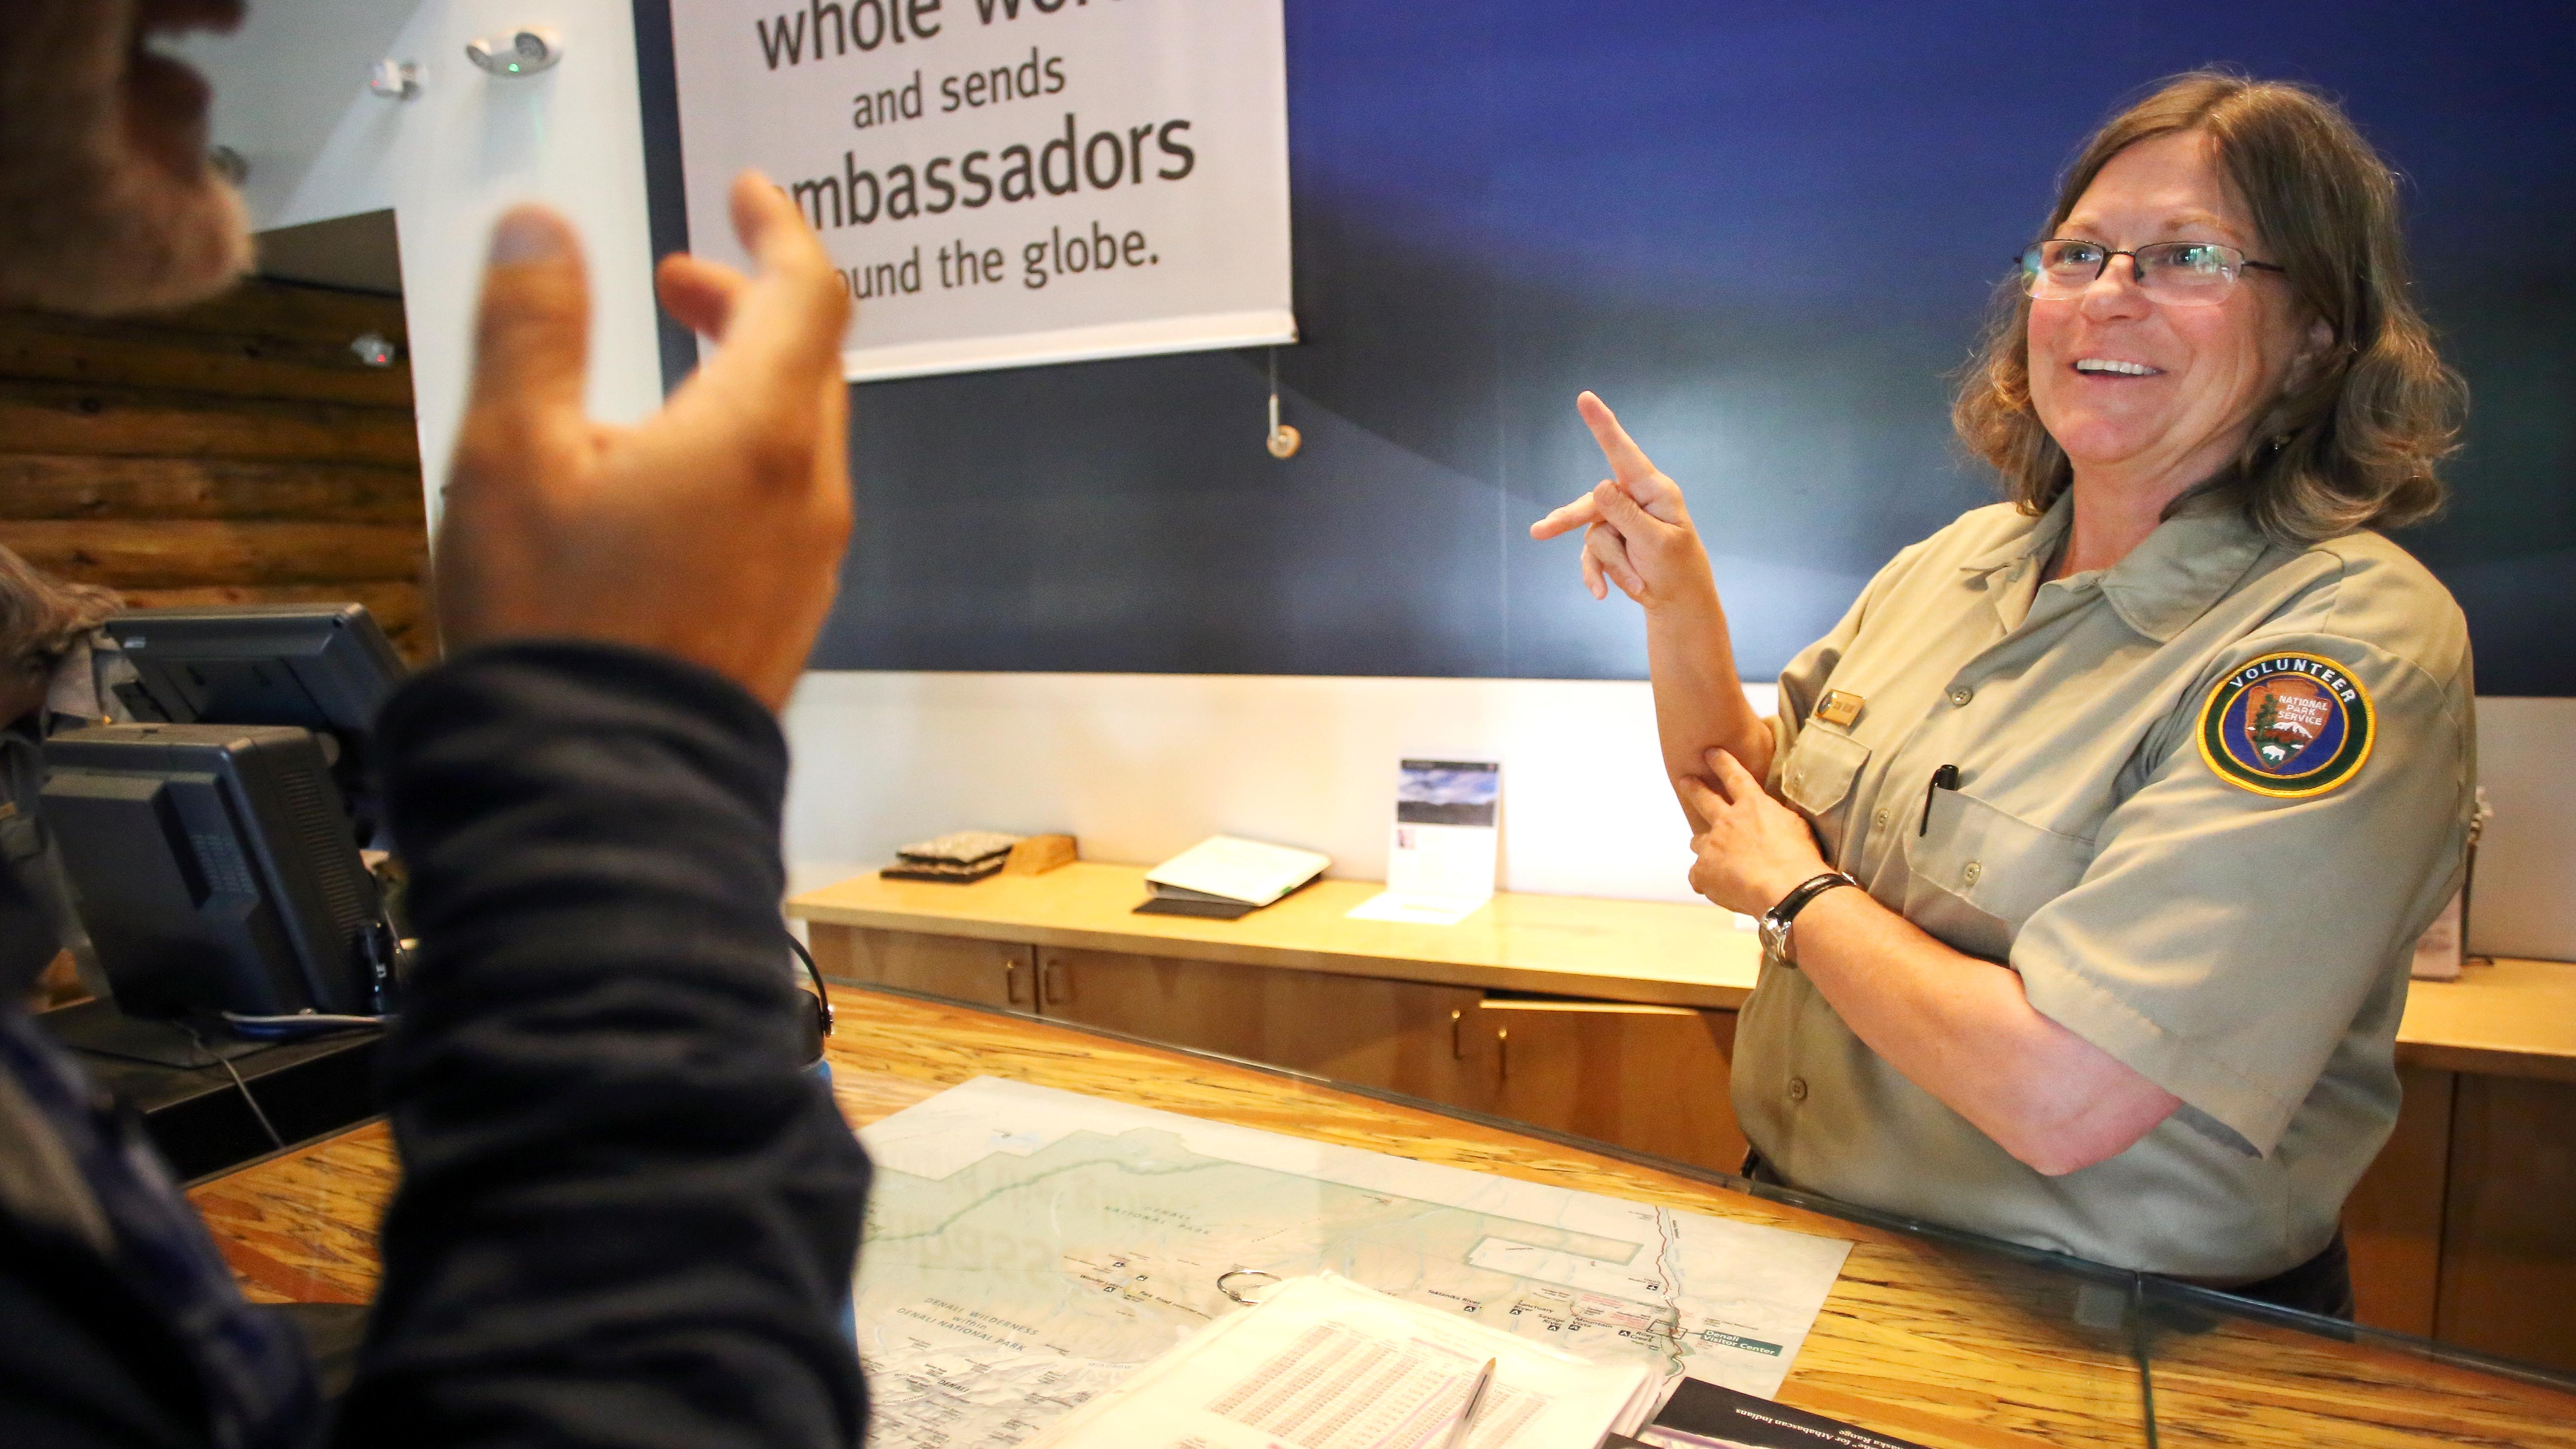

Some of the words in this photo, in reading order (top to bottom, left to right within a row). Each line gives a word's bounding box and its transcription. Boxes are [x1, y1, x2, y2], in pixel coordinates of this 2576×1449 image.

[757, 0, 942, 71] whole
[853, 70, 923, 129] and
[940, 46, 1066, 113] sends
[774, 113, 1196, 230] mbassadors
[938, 236, 1004, 290] the
[1023, 220, 1160, 290] globe.
[2229, 658, 2357, 703] VOLUNTEER
[2278, 695, 2328, 711] NATIONAL
[2286, 704, 2316, 716] PARK
[2278, 710, 2323, 726] SERVICE
[924, 1297, 965, 1313] DENALI
[969, 1311, 1039, 1336] WILDERNESS
[952, 1316, 988, 1329] within
[1537, 1313, 1565, 1323] Savage
[1575, 1316, 1613, 1329] Mountain
[897, 1307, 937, 1323] DENALI
[937, 1320, 993, 1342] NATIONAL
[995, 1338, 1027, 1352] PARK
[1635, 1330, 1655, 1339] Riley
[1706, 1330, 1739, 1342] Denali
[1630, 1334, 1652, 1343] Creek
[1703, 1334, 1737, 1347] Visitor
[1739, 1343, 1776, 1356] Center
[937, 1379, 970, 1393] DENALI
[1735, 1407, 1773, 1425] Indians
[1775, 1419, 1835, 1440] Athabascan
[1838, 1429, 1872, 1445] Range
[1835, 1436, 1852, 1446] for
